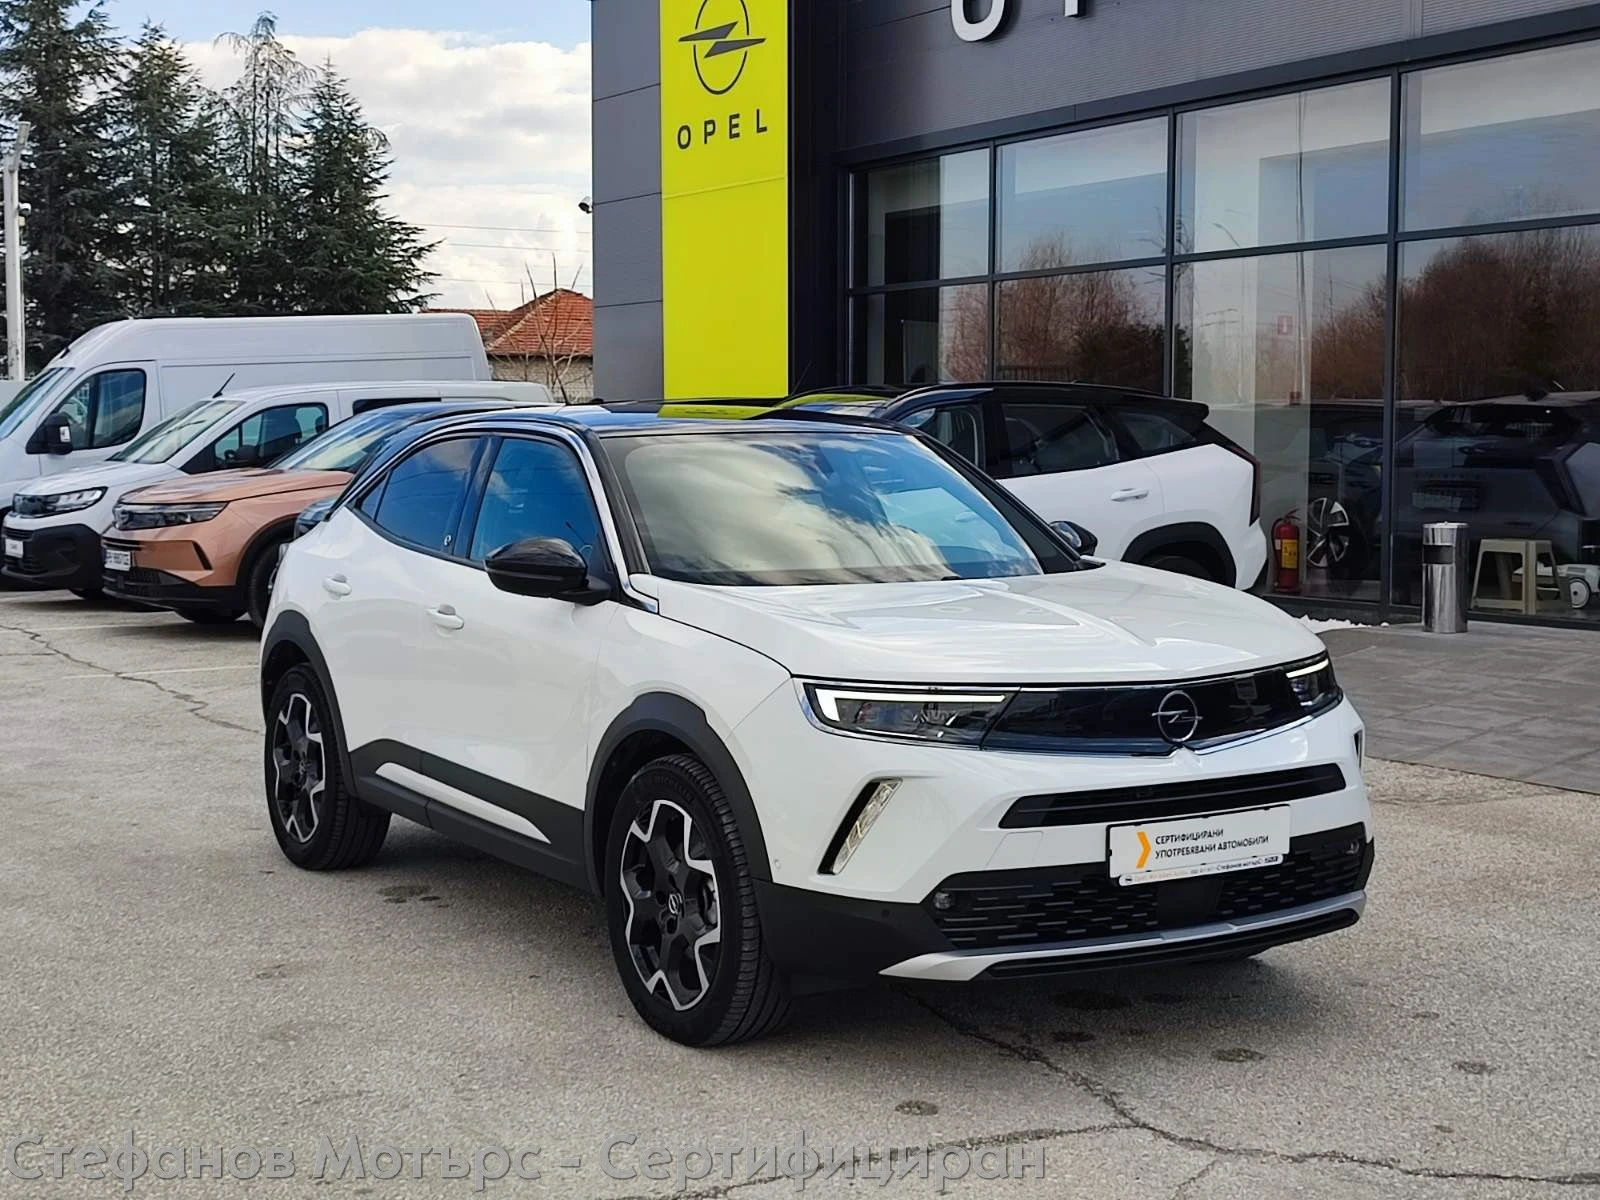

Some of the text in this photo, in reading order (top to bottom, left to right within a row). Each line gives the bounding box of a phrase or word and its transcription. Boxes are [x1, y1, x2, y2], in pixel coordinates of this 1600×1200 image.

[677, 108, 768, 150] OPEL
[1155, 829, 1223, 844] СЕРТИФИЦИРАНИ
[1155, 836, 1269, 859] УПОТРЕБЯВАНИ АВТОМОБИЛИ
